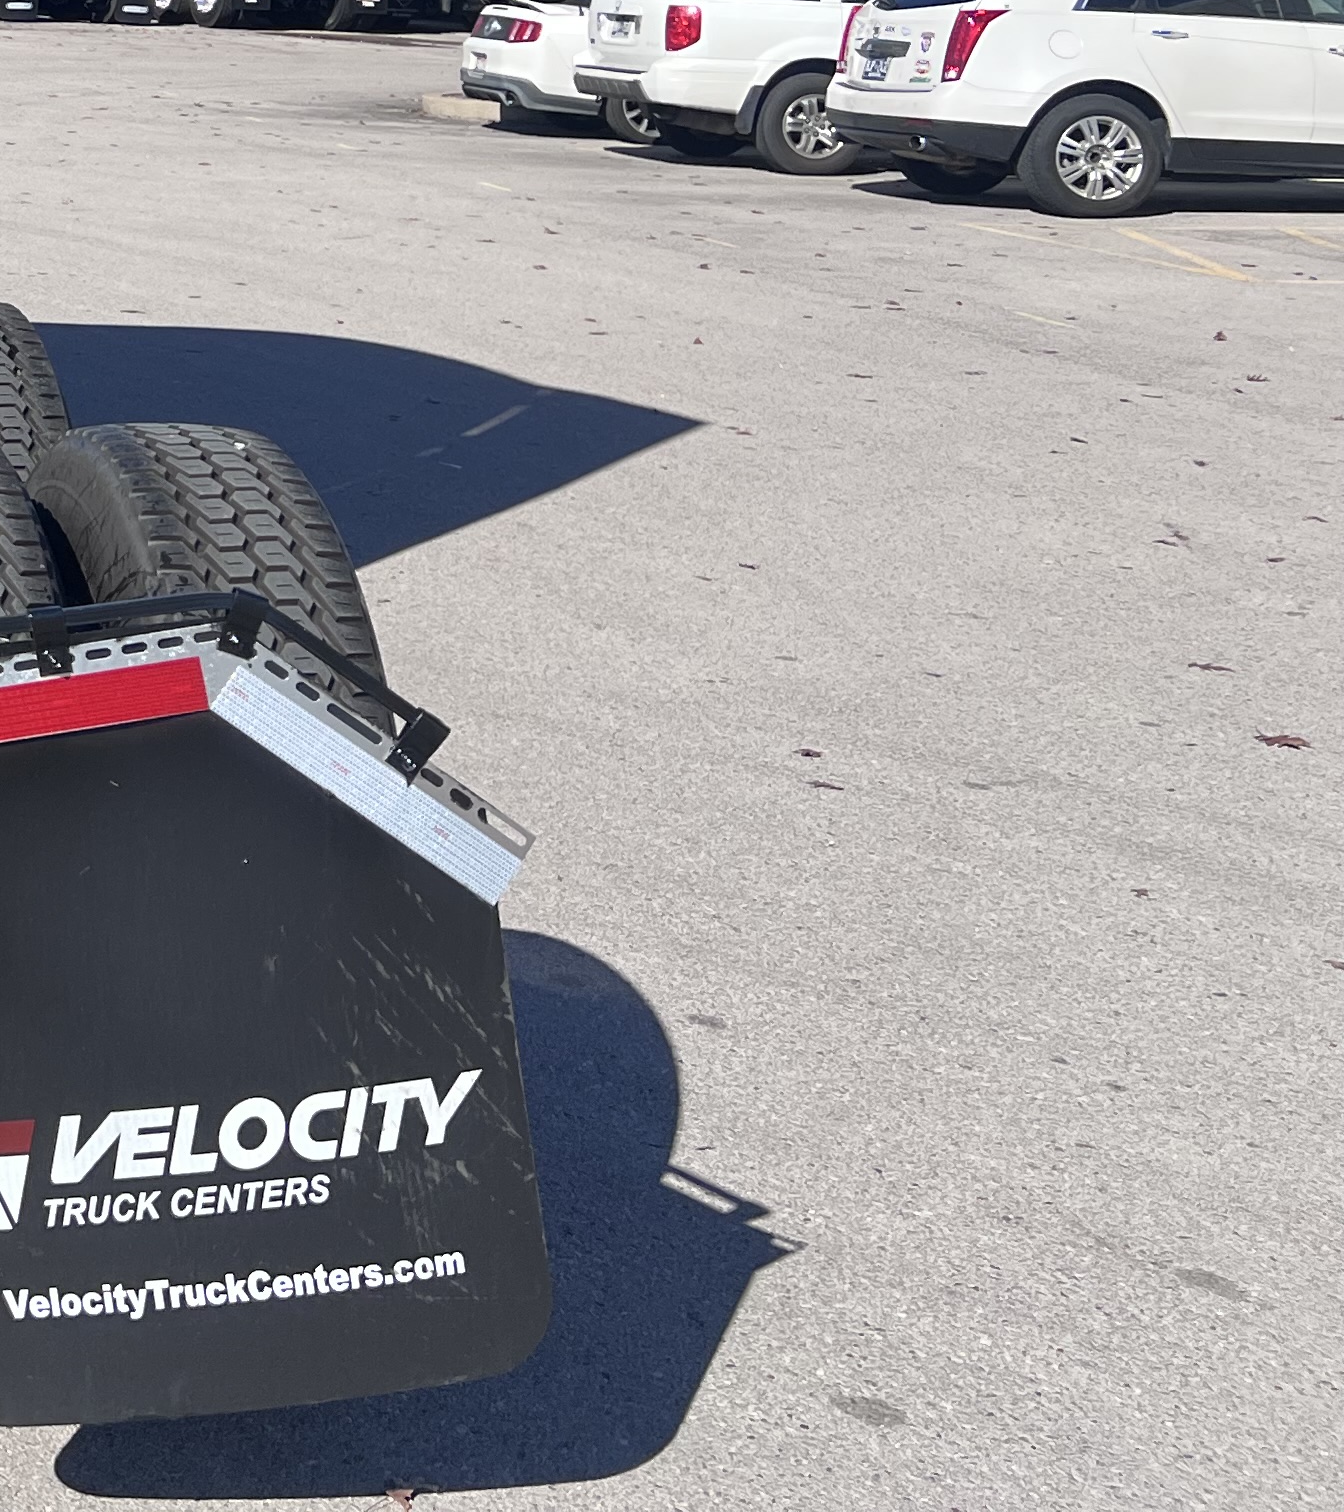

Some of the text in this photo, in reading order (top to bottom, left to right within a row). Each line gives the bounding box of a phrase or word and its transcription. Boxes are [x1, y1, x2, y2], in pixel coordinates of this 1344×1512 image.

[50, 1069, 483, 1184] VELOCITY
[43, 1173, 331, 1229] TRUCK CENTERS
[3, 1251, 466, 1320] VelocityTruckCenters.com
